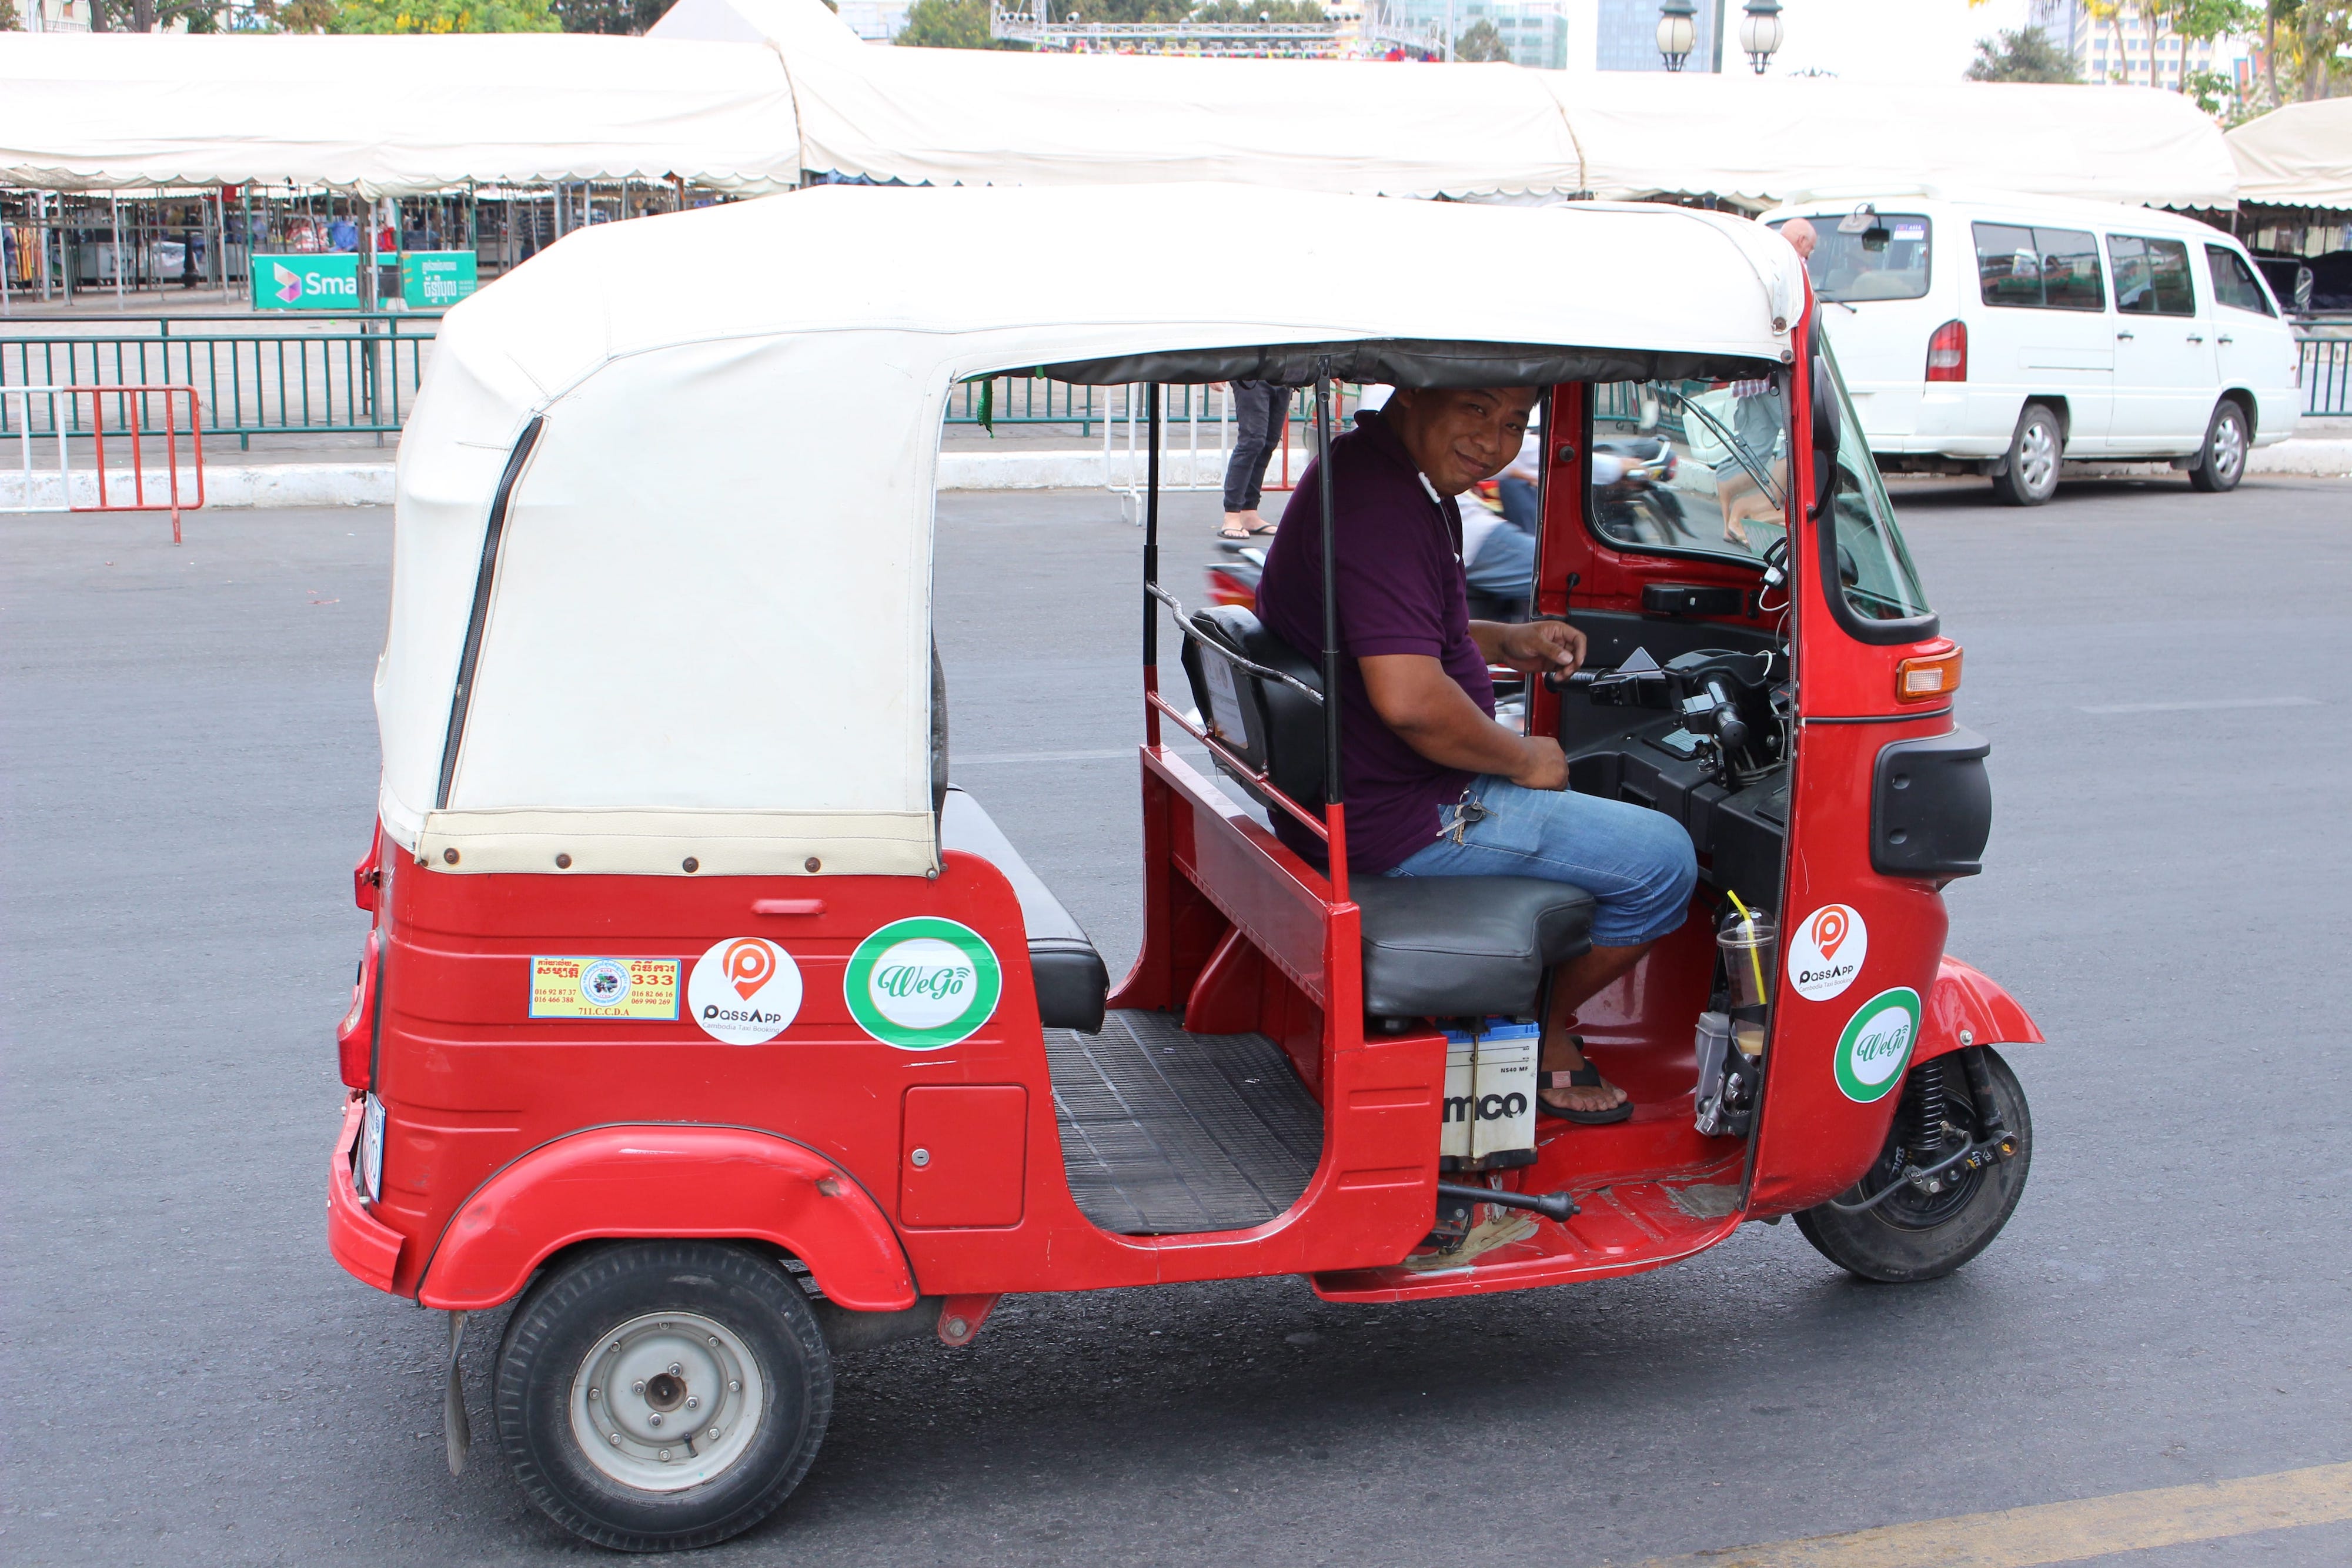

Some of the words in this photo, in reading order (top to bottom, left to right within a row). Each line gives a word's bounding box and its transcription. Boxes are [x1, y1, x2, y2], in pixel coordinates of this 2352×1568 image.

[878, 966, 963, 999] WeGo
[1799, 983, 1823, 992] Cambodia
[579, 1008, 630, 1016] 711.C.C.D.A
[1857, 1028, 1905, 1062] WeGo
